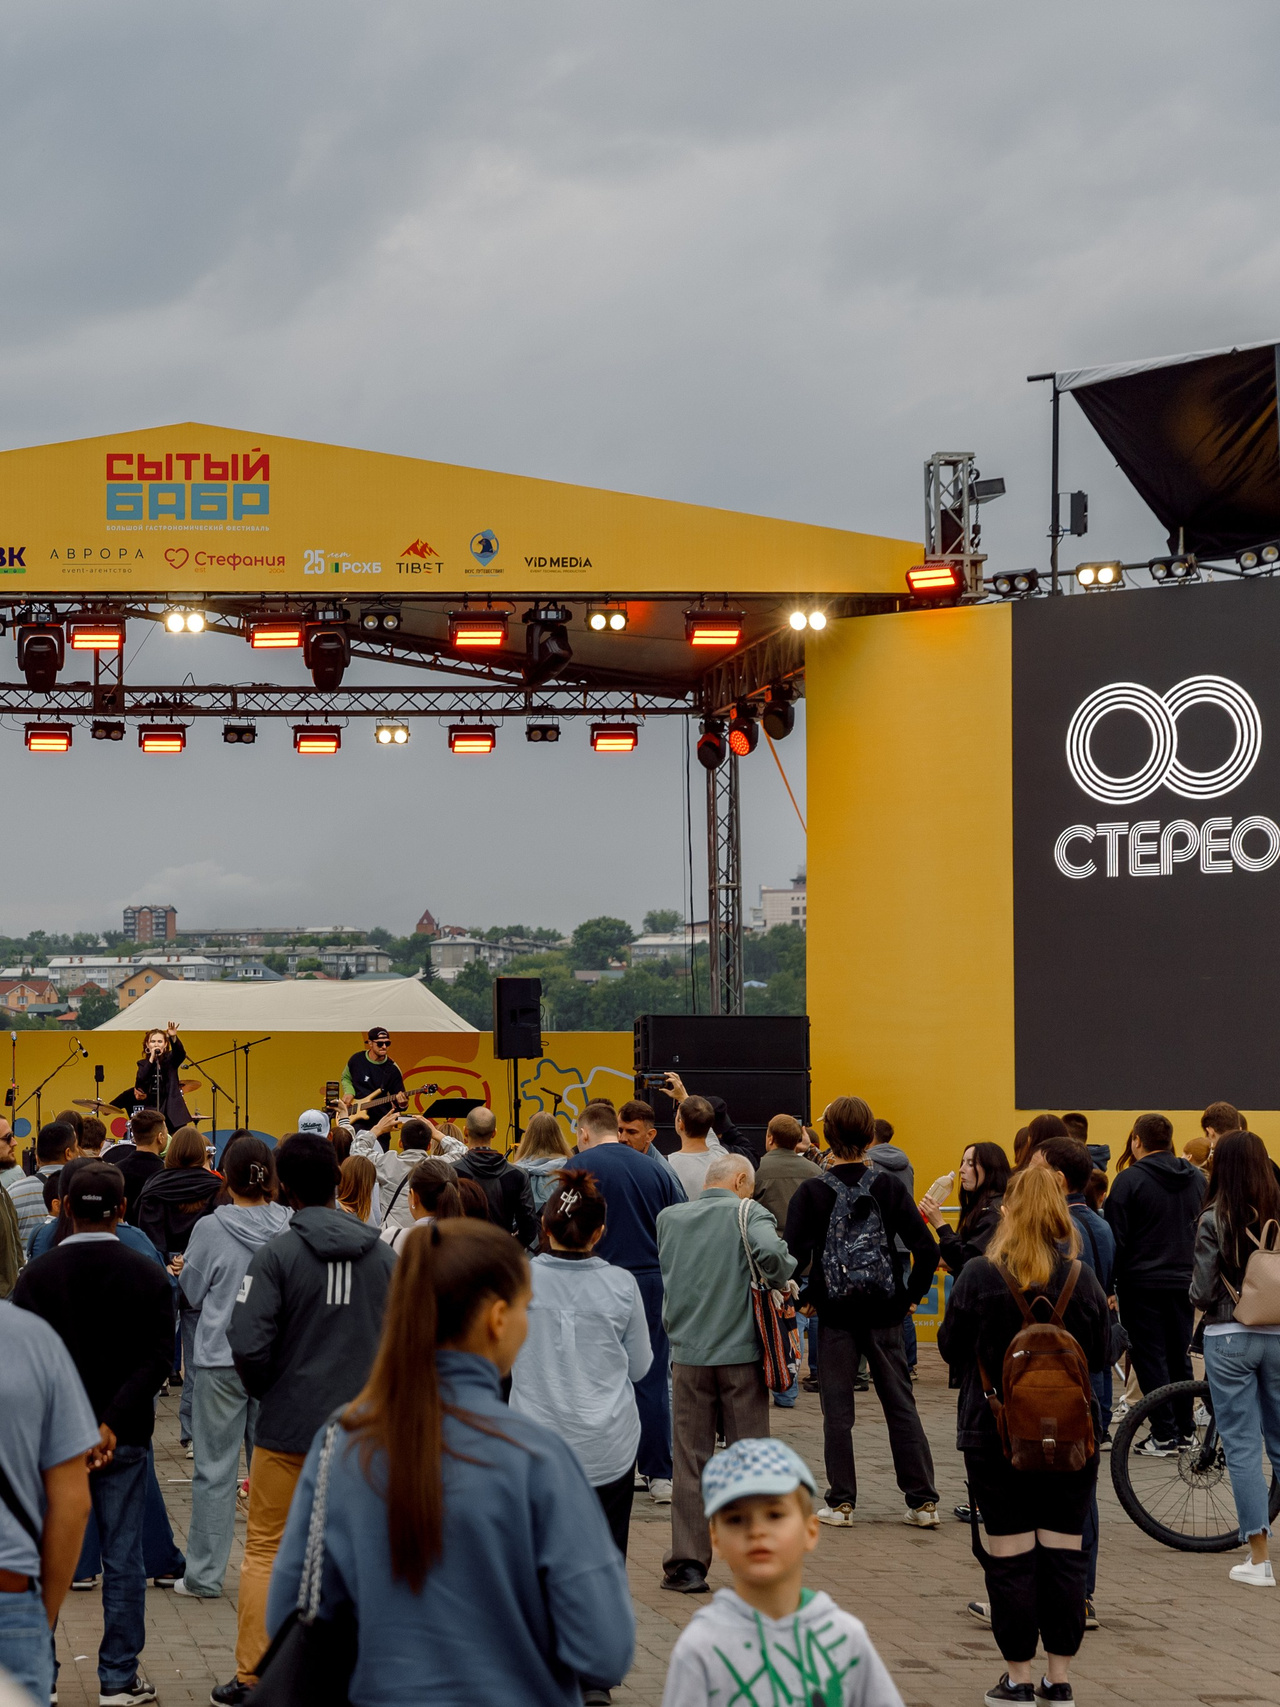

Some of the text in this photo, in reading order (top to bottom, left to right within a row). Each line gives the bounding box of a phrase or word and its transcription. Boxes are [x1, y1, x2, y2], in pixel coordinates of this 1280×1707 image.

[106, 447, 270, 481] СЫТЫЙ
[106, 483, 270, 521] БАБР
[145, 524, 224, 532] ГАСТРОНОМИЧЕСКИЙ
[49, 548, 144, 560] АВРОРА
[194, 551, 286, 571] Стефания
[303, 549, 325, 575] 25
[342, 562, 382, 574] РСХБ
[396, 562, 444, 574] TIBET
[1053, 815, 1280, 880] СТЕРЕО
